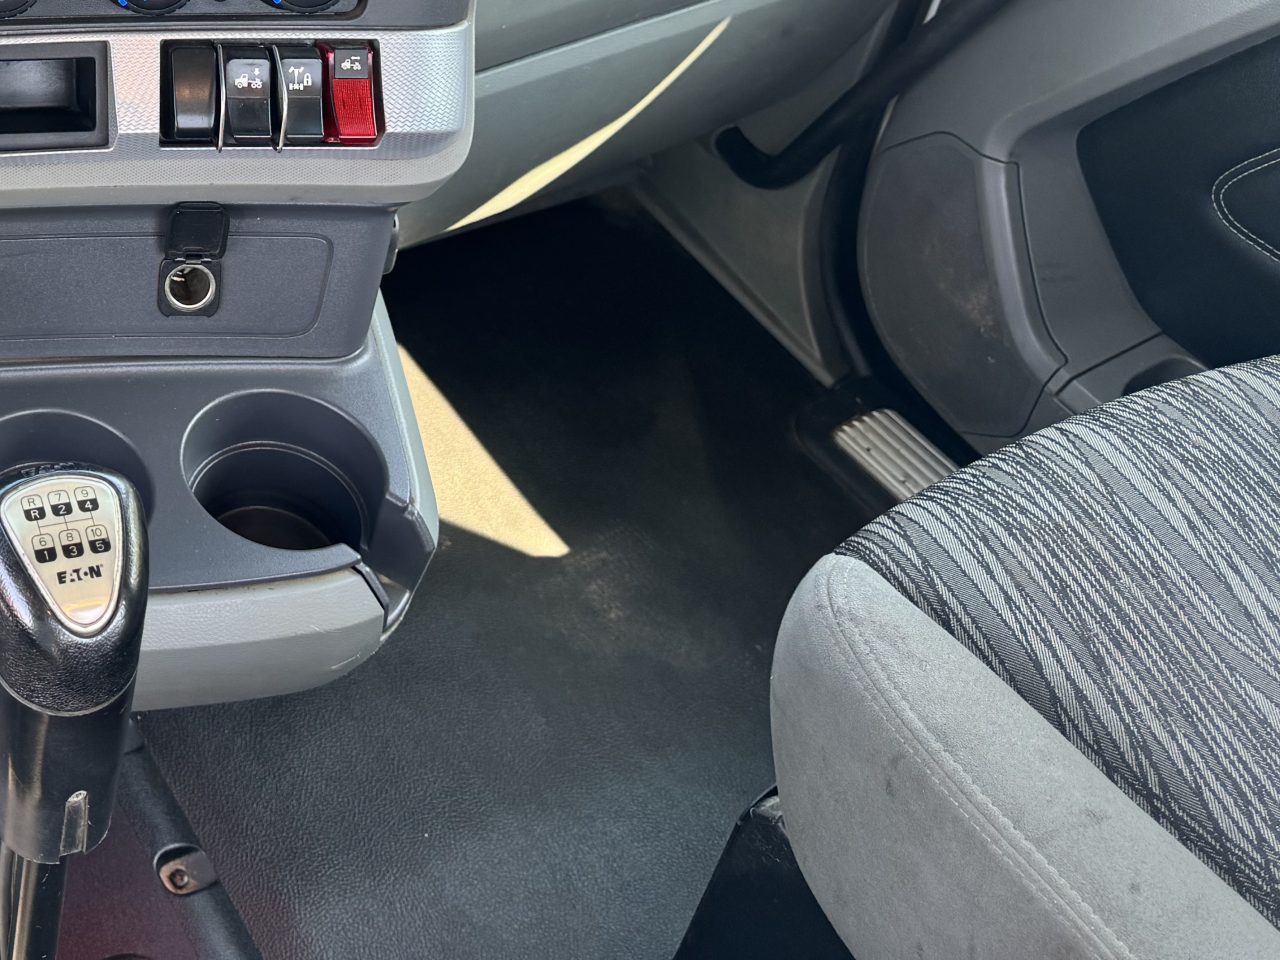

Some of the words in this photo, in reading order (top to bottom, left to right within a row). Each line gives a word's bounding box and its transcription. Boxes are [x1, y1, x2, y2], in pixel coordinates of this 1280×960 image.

[53, 492, 62, 503] 7
[81, 489, 89, 498] 9
[27, 498, 36, 507] R
[84, 500, 94, 511] 4
[31, 509, 40, 519] R
[58, 505, 67, 515] 2
[91, 526, 103, 538] 10
[38, 537, 47, 547] 6
[66, 532, 75, 543] 8
[69, 546, 78, 556] 3
[96, 541, 105, 551] 5
[43, 550, 50, 561] 1
